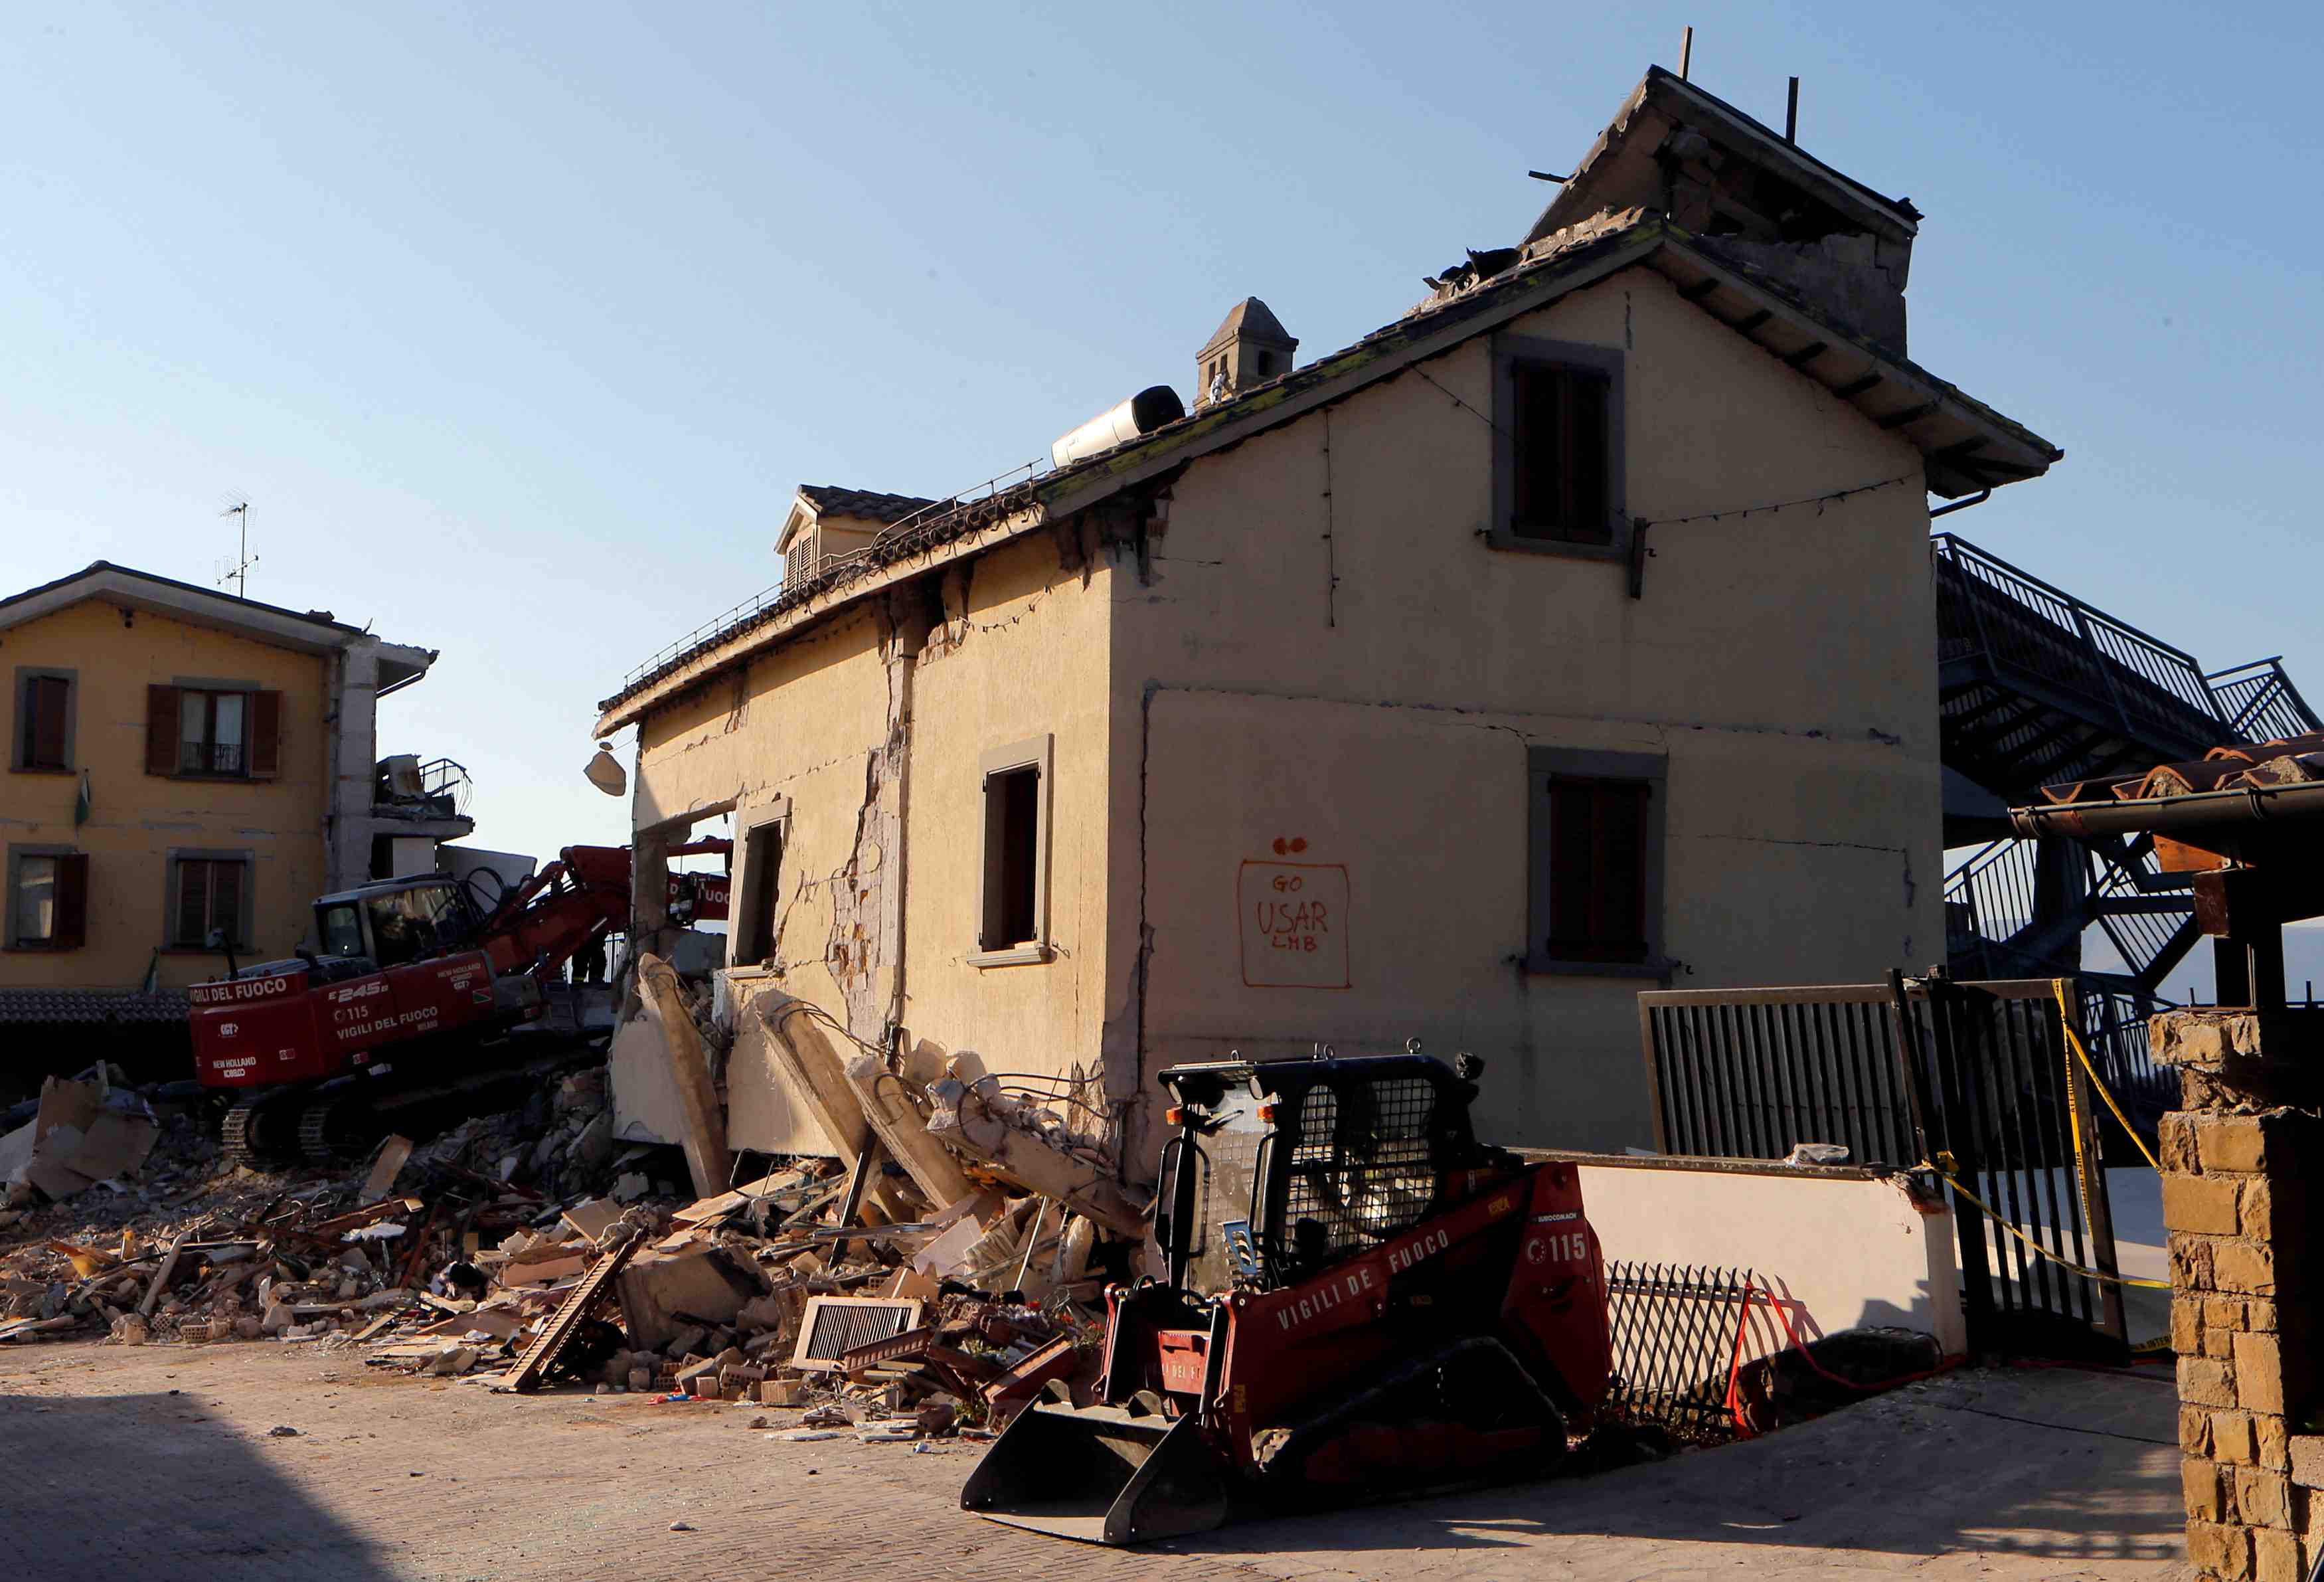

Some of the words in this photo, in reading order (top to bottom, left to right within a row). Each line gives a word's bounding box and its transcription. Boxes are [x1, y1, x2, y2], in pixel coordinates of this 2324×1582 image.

[1272, 875, 1303, 892] GO
[1257, 901, 1328, 934] USAR
[211, 986, 233, 1002] DEL
[234, 978, 288, 999] FUOCO
[336, 1022, 373, 1040] VIGILI
[374, 1016, 398, 1031] DEL
[399, 1006, 438, 1025] FUOCO
[226, 1057, 257, 1068] HOLLAND
[1276, 1284, 1342, 1331] VIGILI
[1388, 1228, 1450, 1275] FUOCO
